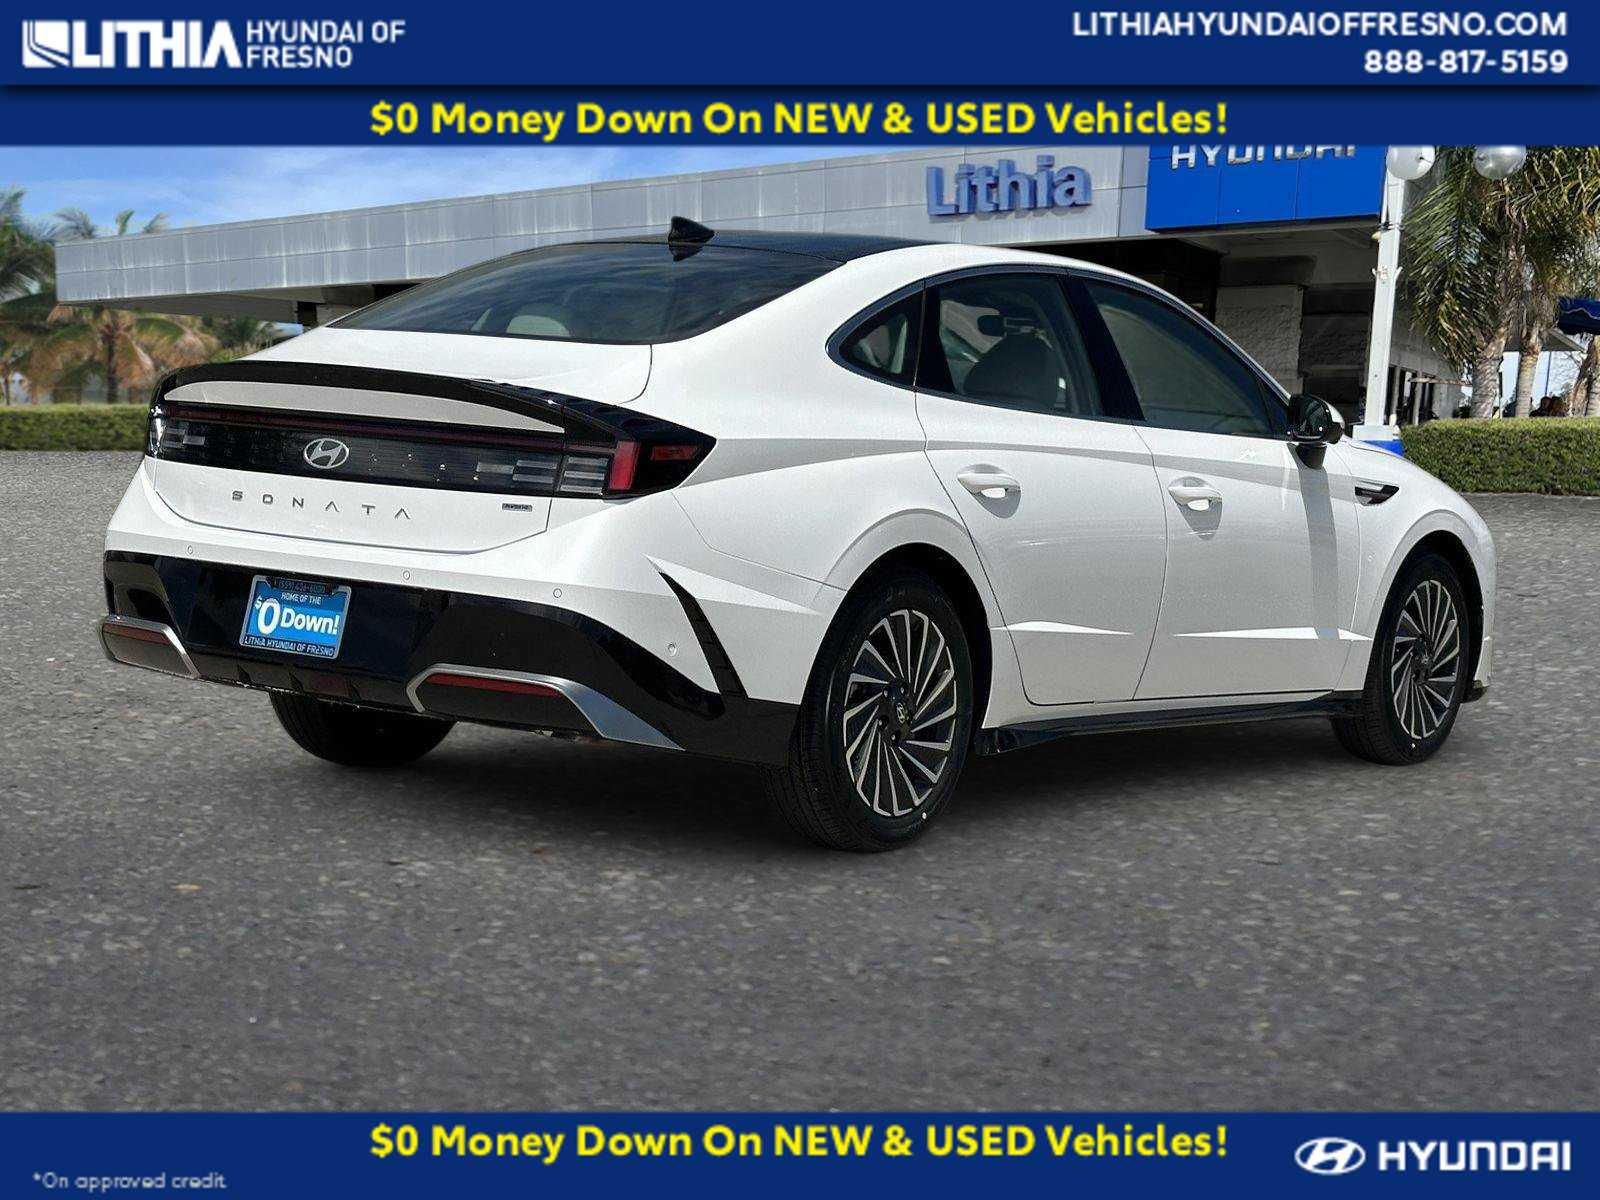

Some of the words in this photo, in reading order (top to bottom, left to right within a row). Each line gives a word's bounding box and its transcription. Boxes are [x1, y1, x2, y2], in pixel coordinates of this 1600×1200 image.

[926, 155, 1092, 215] Lithia
[231, 490, 411, 520] SONATA
[280, 607, 340, 635] Down!
[266, 639, 296, 651] HYUNDAI
[297, 643, 306, 652] OF
[306, 645, 334, 657] FRESNO
